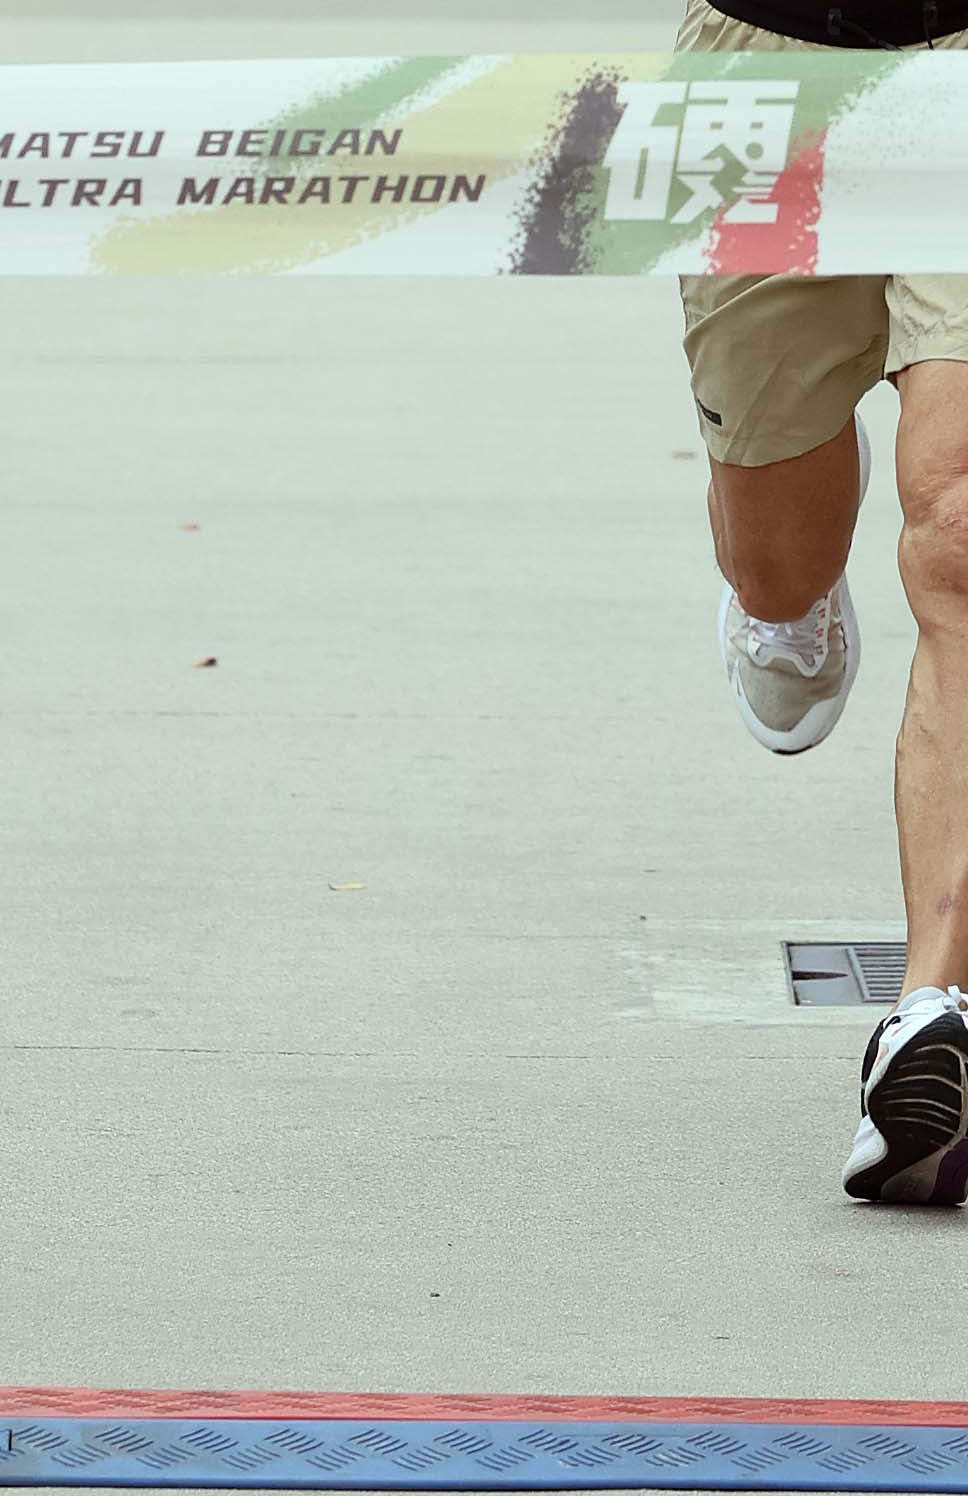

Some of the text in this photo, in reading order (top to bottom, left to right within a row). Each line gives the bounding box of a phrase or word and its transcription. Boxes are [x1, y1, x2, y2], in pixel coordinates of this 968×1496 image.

[195, 128, 402, 157] BEIGAN
[603, 81, 798, 224] 硬
[0, 174, 486, 207] LTRA MARATHON
